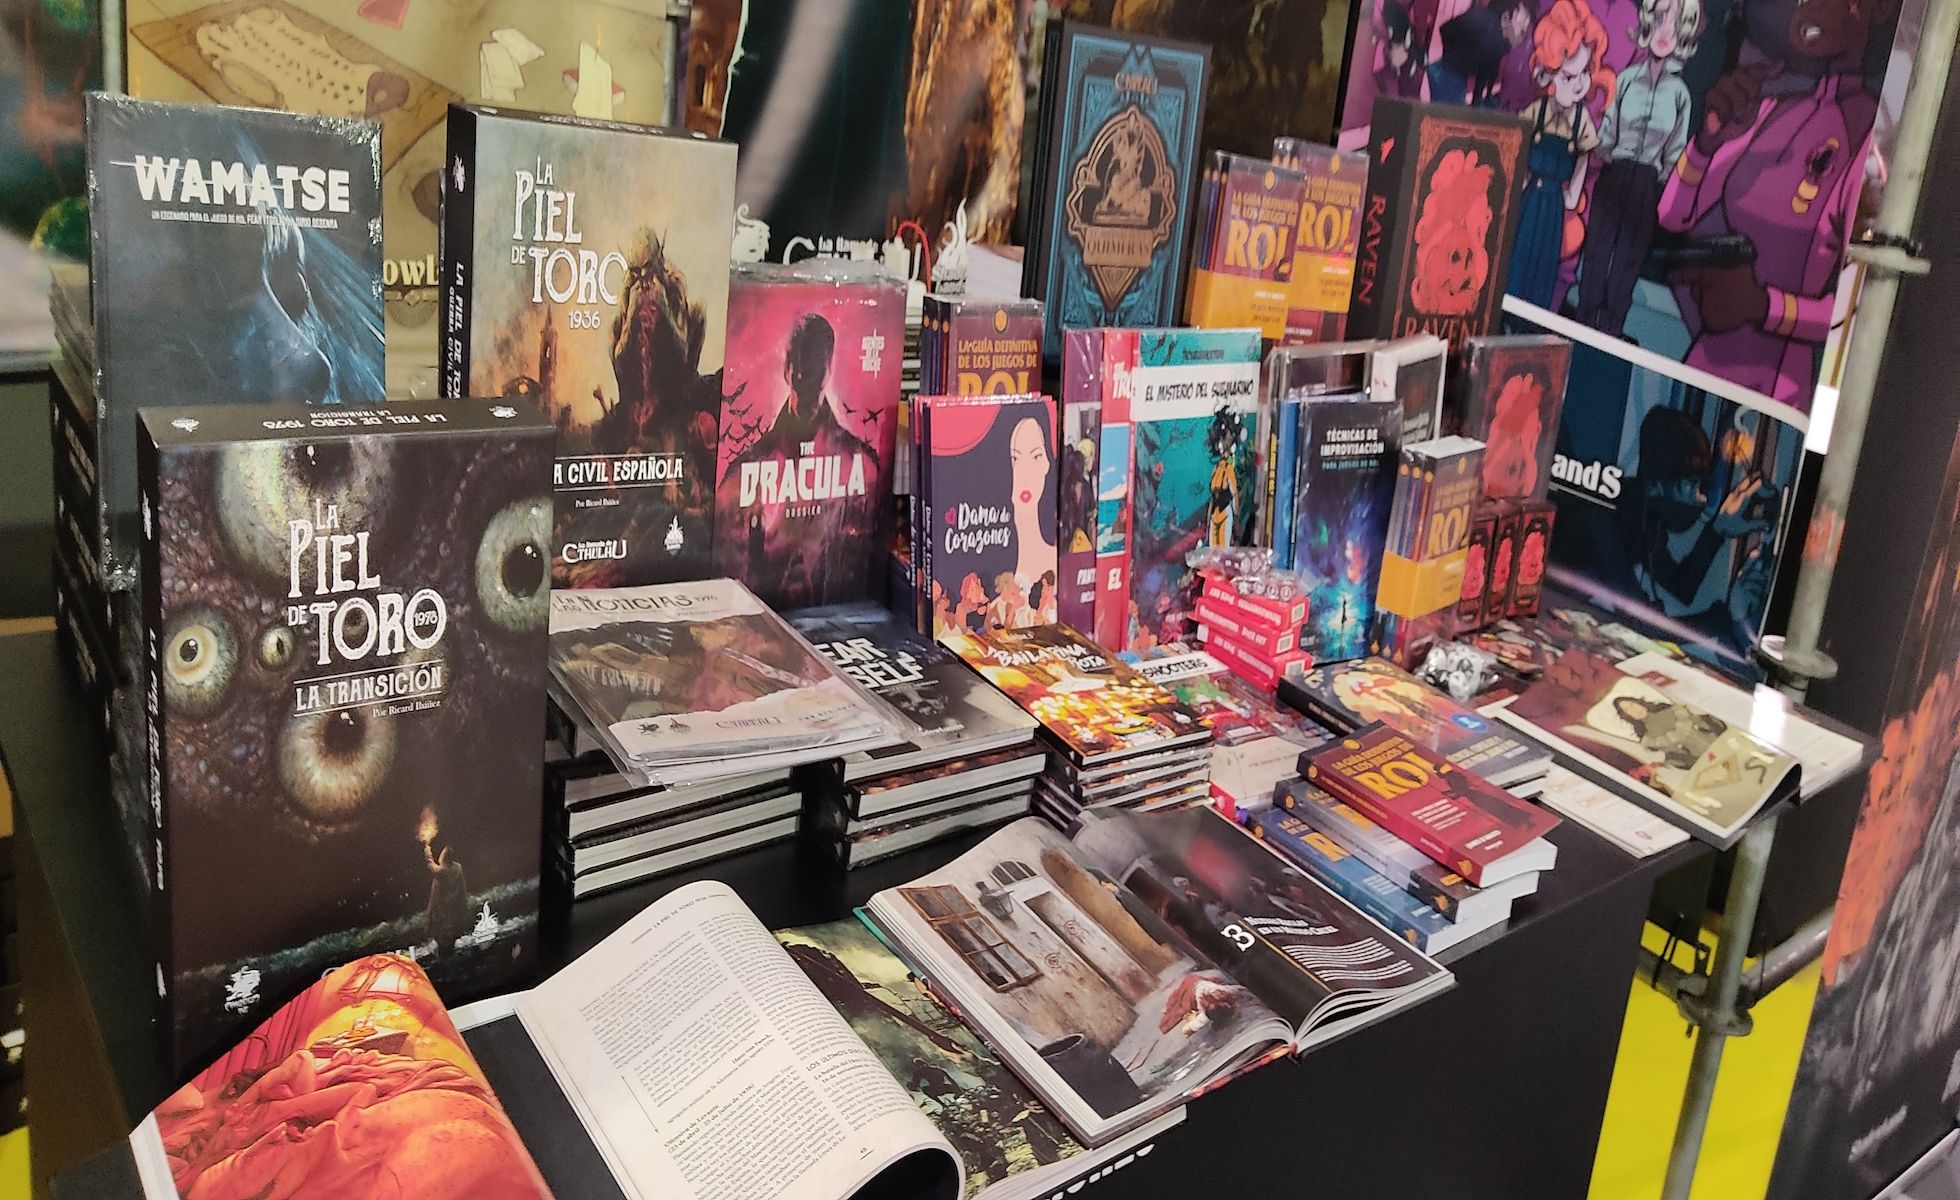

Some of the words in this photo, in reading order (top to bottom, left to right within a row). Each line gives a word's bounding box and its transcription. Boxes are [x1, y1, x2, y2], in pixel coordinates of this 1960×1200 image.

[536, 155, 554, 186] LA
[134, 155, 350, 213] WAMATSE
[512, 170, 582, 244] PIEL
[511, 246, 526, 265] DE
[1358, 194, 1387, 304] RAVEN
[456, 261, 465, 286] LA
[454, 295, 464, 331] PIEL
[569, 310, 601, 329] 1936
[453, 338, 462, 364] DE
[958, 340, 969, 353] LA
[970, 338, 993, 354] GUÍA
[994, 339, 1037, 353] DEFINITIVA
[958, 354, 971, 368] DE
[973, 354, 990, 368] LOS
[991, 354, 1024, 369] JUEGOS
[1027, 354, 1038, 367] DE
[1157, 381, 1194, 401] MISTERIO
[311, 418, 358, 428] TORO
[361, 416, 383, 426] DE
[387, 414, 421, 425] PIEL
[424, 413, 447, 423] LA
[1326, 427, 1365, 443] TÉCNICAS
[1367, 428, 1378, 441] DE
[800, 441, 815, 455] THE
[1320, 441, 1385, 457] IMPROVISACIÓN
[567, 461, 609, 484] CIVIL
[613, 456, 684, 482] ESPAÑOLA
[739, 453, 865, 508] DRACULA
[1552, 453, 1623, 501] andS
[316, 498, 339, 530] LA
[958, 502, 998, 529] Dama
[1000, 507, 1011, 523] de
[562, 539, 627, 563] CTHULHU
[945, 526, 1012, 555] Corazones
[288, 519, 381, 598] PIEL
[288, 605, 307, 627] DE
[309, 588, 447, 665] TORO
[296, 686, 319, 711] LA
[326, 665, 442, 705] TRANSICIÓN
[372, 706, 386, 718] Por
[388, 702, 413, 717] Ricard
[1220, 924, 1256, 952] 3
[806, 1060, 821, 1072] LOS
